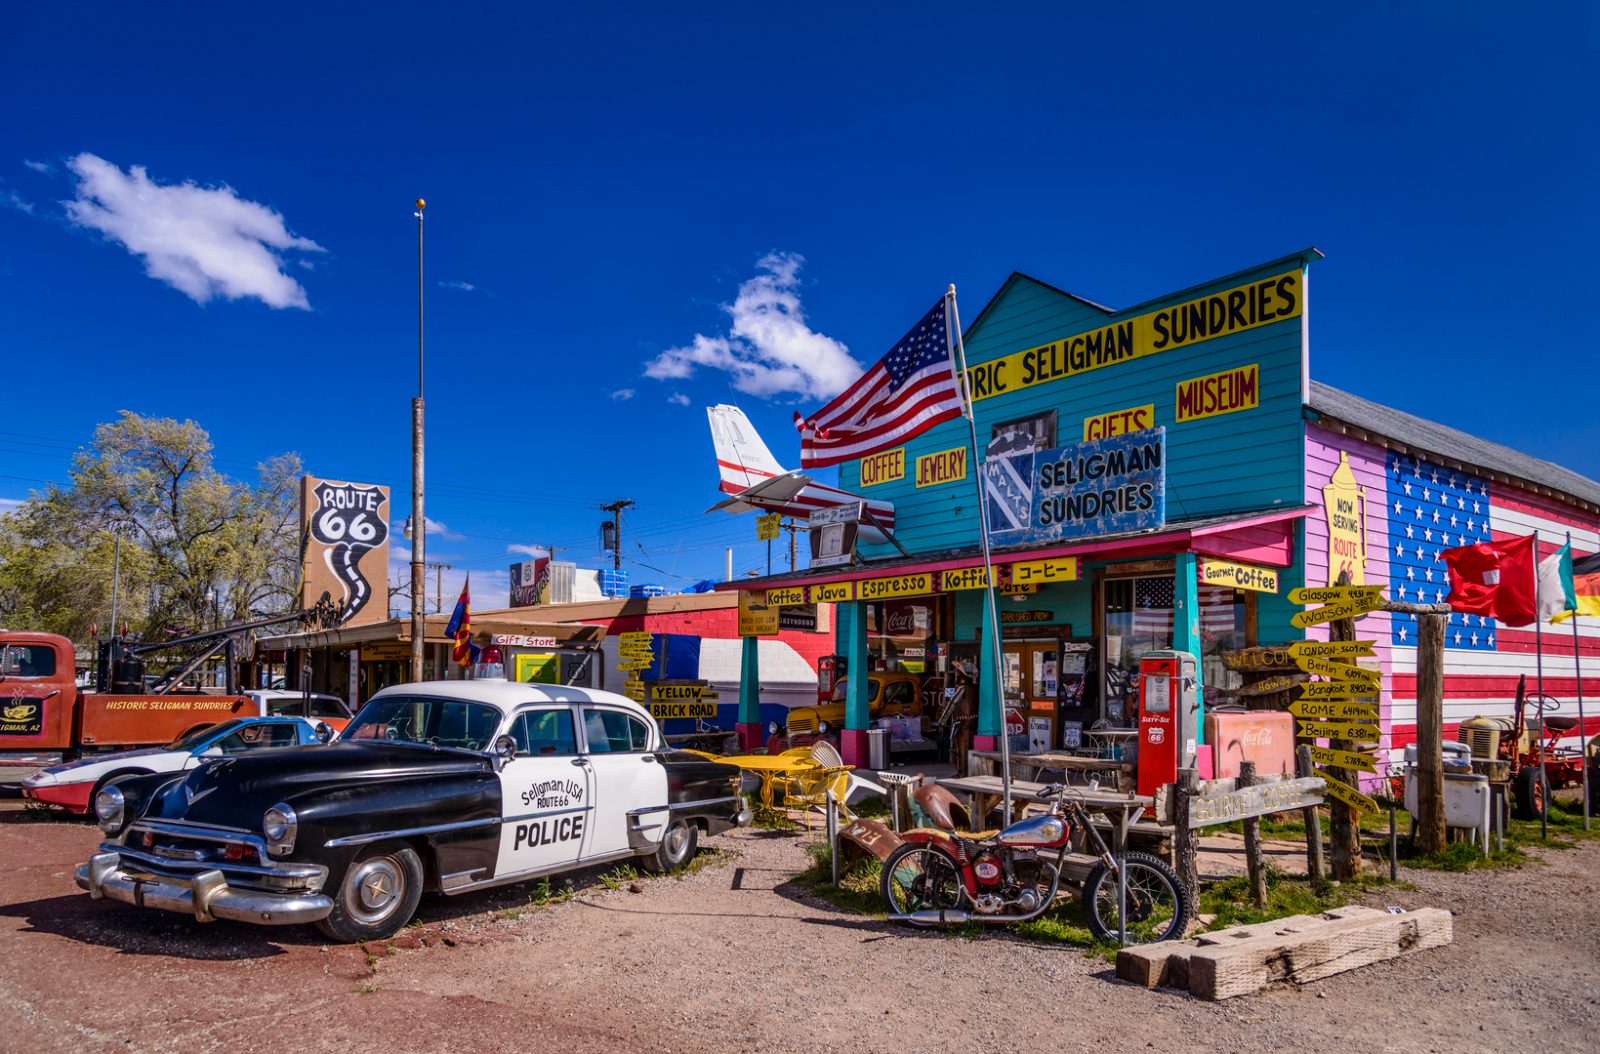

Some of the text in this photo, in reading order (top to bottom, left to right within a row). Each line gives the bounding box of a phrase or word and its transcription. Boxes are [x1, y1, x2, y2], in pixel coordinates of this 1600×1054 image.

[1021, 321, 1134, 385] SELIGMAN
[1153, 275, 1296, 349] SUNDRIES
[1178, 367, 1256, 420] MUSEUM
[1088, 409, 1147, 441] GIFTS
[862, 450, 902, 484] COFFEE
[917, 449, 965, 485] JEWELRY
[1040, 442, 1162, 489] SELIGMAN
[323, 488, 377, 511] ROUTE
[988, 463, 1028, 520] MALTS
[1040, 483, 1153, 525] SUNDRIES
[1337, 498, 1353, 514] NOW
[319, 508, 376, 541] 66
[1333, 514, 1358, 533] SERVING
[1333, 537, 1357, 559] ROUTE
[946, 569, 988, 588] Koffie
[1020, 563, 1067, 579] コーヒー
[1206, 566, 1275, 589] Gourmet Coffee
[817, 585, 846, 601] Java
[862, 576, 926, 597] Espresso
[768, 590, 802, 605] Kaffee
[1300, 605, 1353, 624] Warsaw
[496, 636, 553, 646] Gift Store
[656, 688, 701, 698] YELLOW
[922, 691, 945, 707] STO
[1309, 684, 1345, 697] Bangkok
[106, 702, 232, 710] HISTORIC SELIGMAN SUNDRIES
[654, 704, 714, 716] BRICK ROAD
[1301, 704, 1336, 715] ROME
[1306, 723, 1340, 738] Beijing
[1311, 747, 1336, 761] Paris
[566, 778, 583, 802] USA
[537, 795, 569, 809] ROUTE 66
[1196, 783, 1303, 820] GOURMET COFFEE
[514, 815, 583, 851] POLICE
